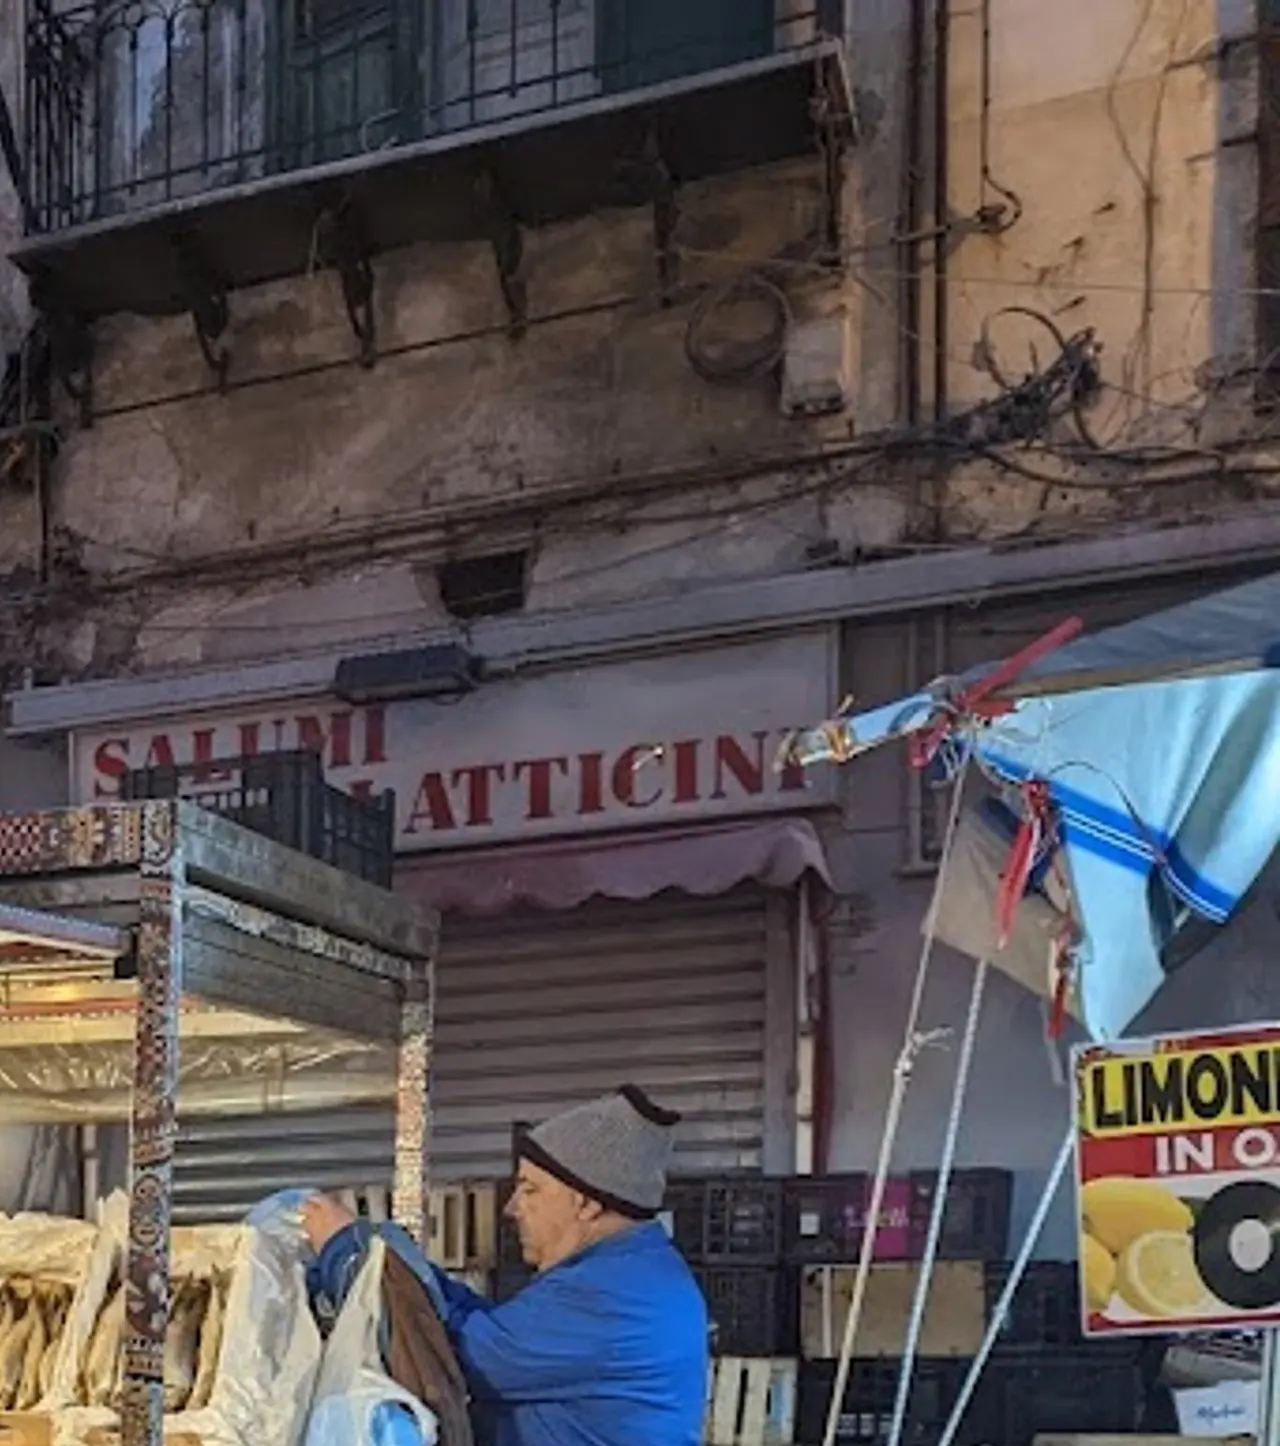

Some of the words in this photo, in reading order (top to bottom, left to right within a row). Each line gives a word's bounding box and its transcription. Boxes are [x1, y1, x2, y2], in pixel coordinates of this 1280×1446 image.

[349, 727, 812, 834] ATTICINI
[1092, 1048, 1280, 1130] LIMON
[1155, 1132, 1215, 1173] IN
[1233, 1127, 1280, 1169] O
